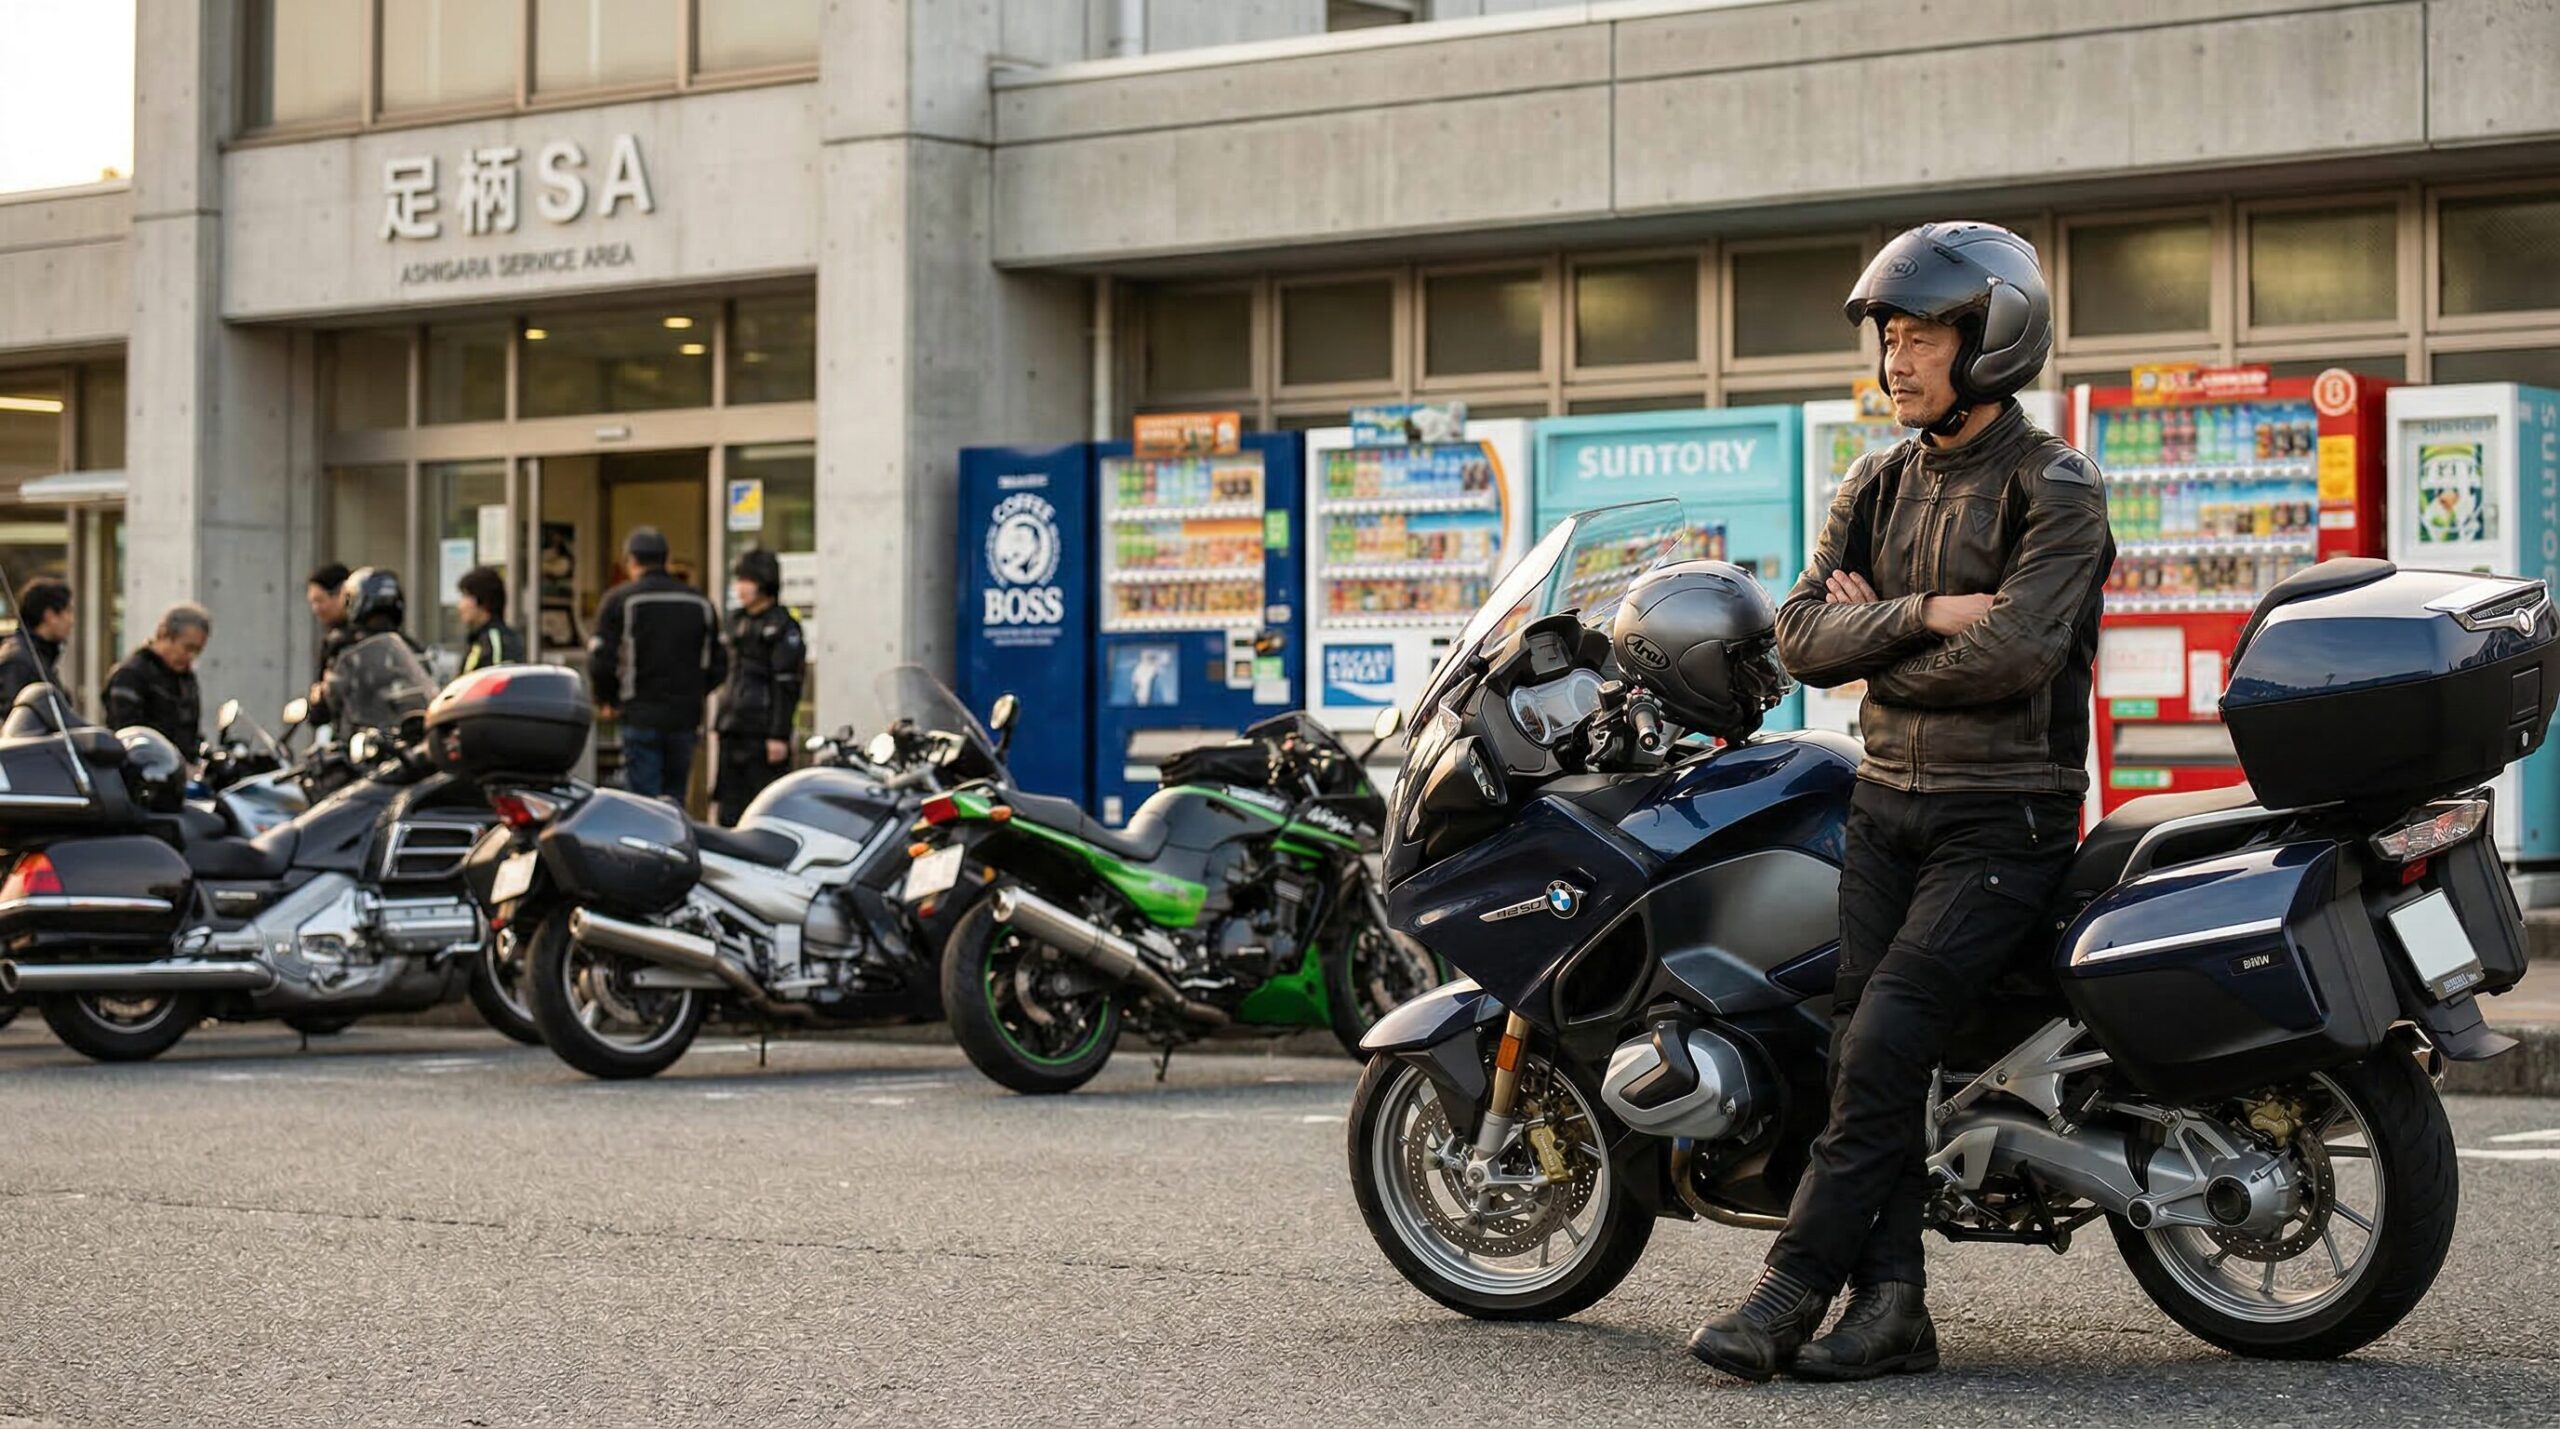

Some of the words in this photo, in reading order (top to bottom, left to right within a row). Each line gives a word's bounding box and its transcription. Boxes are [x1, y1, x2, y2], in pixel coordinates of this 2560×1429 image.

[500, 248, 577, 275] SERVICE
[582, 243, 634, 268] AREA
[1577, 438, 1756, 481] SUNTORY
[983, 587, 1064, 625] BOSS
[1306, 805, 1354, 835] Ninja
